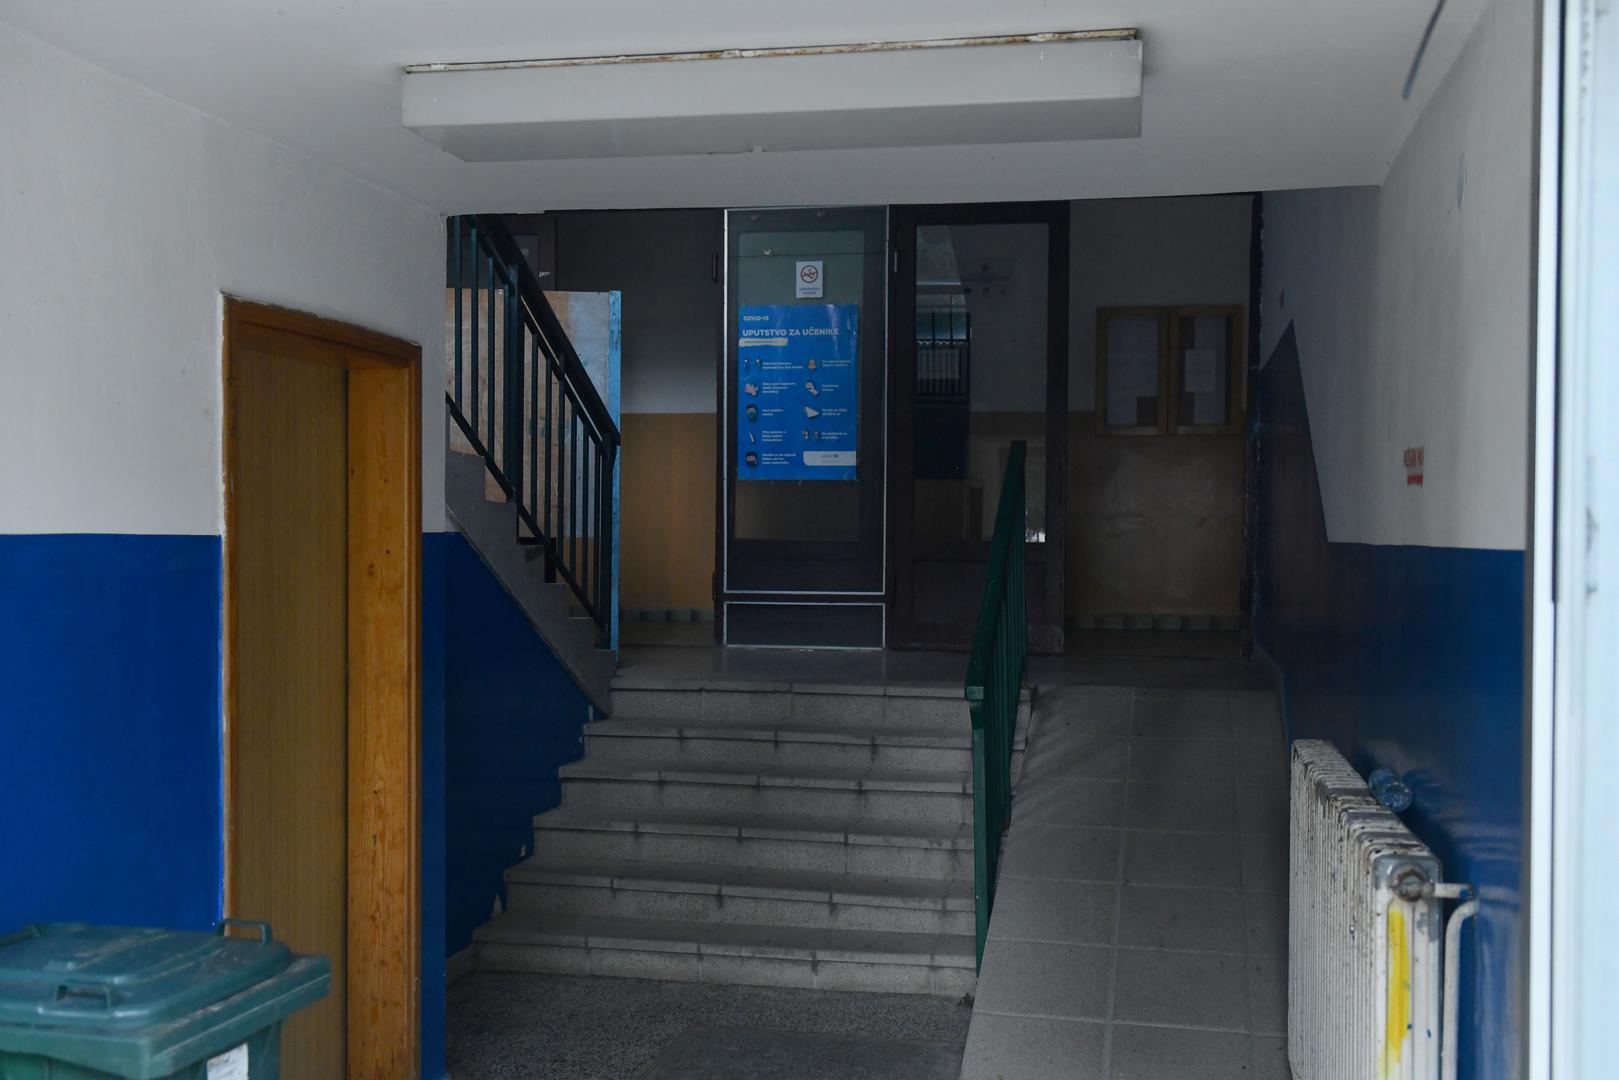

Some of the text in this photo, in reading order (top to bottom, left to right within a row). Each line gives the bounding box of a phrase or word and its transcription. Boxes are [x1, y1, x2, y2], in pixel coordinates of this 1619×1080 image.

[742, 327, 839, 337] UPUTSTVO ZA UČENIKE
